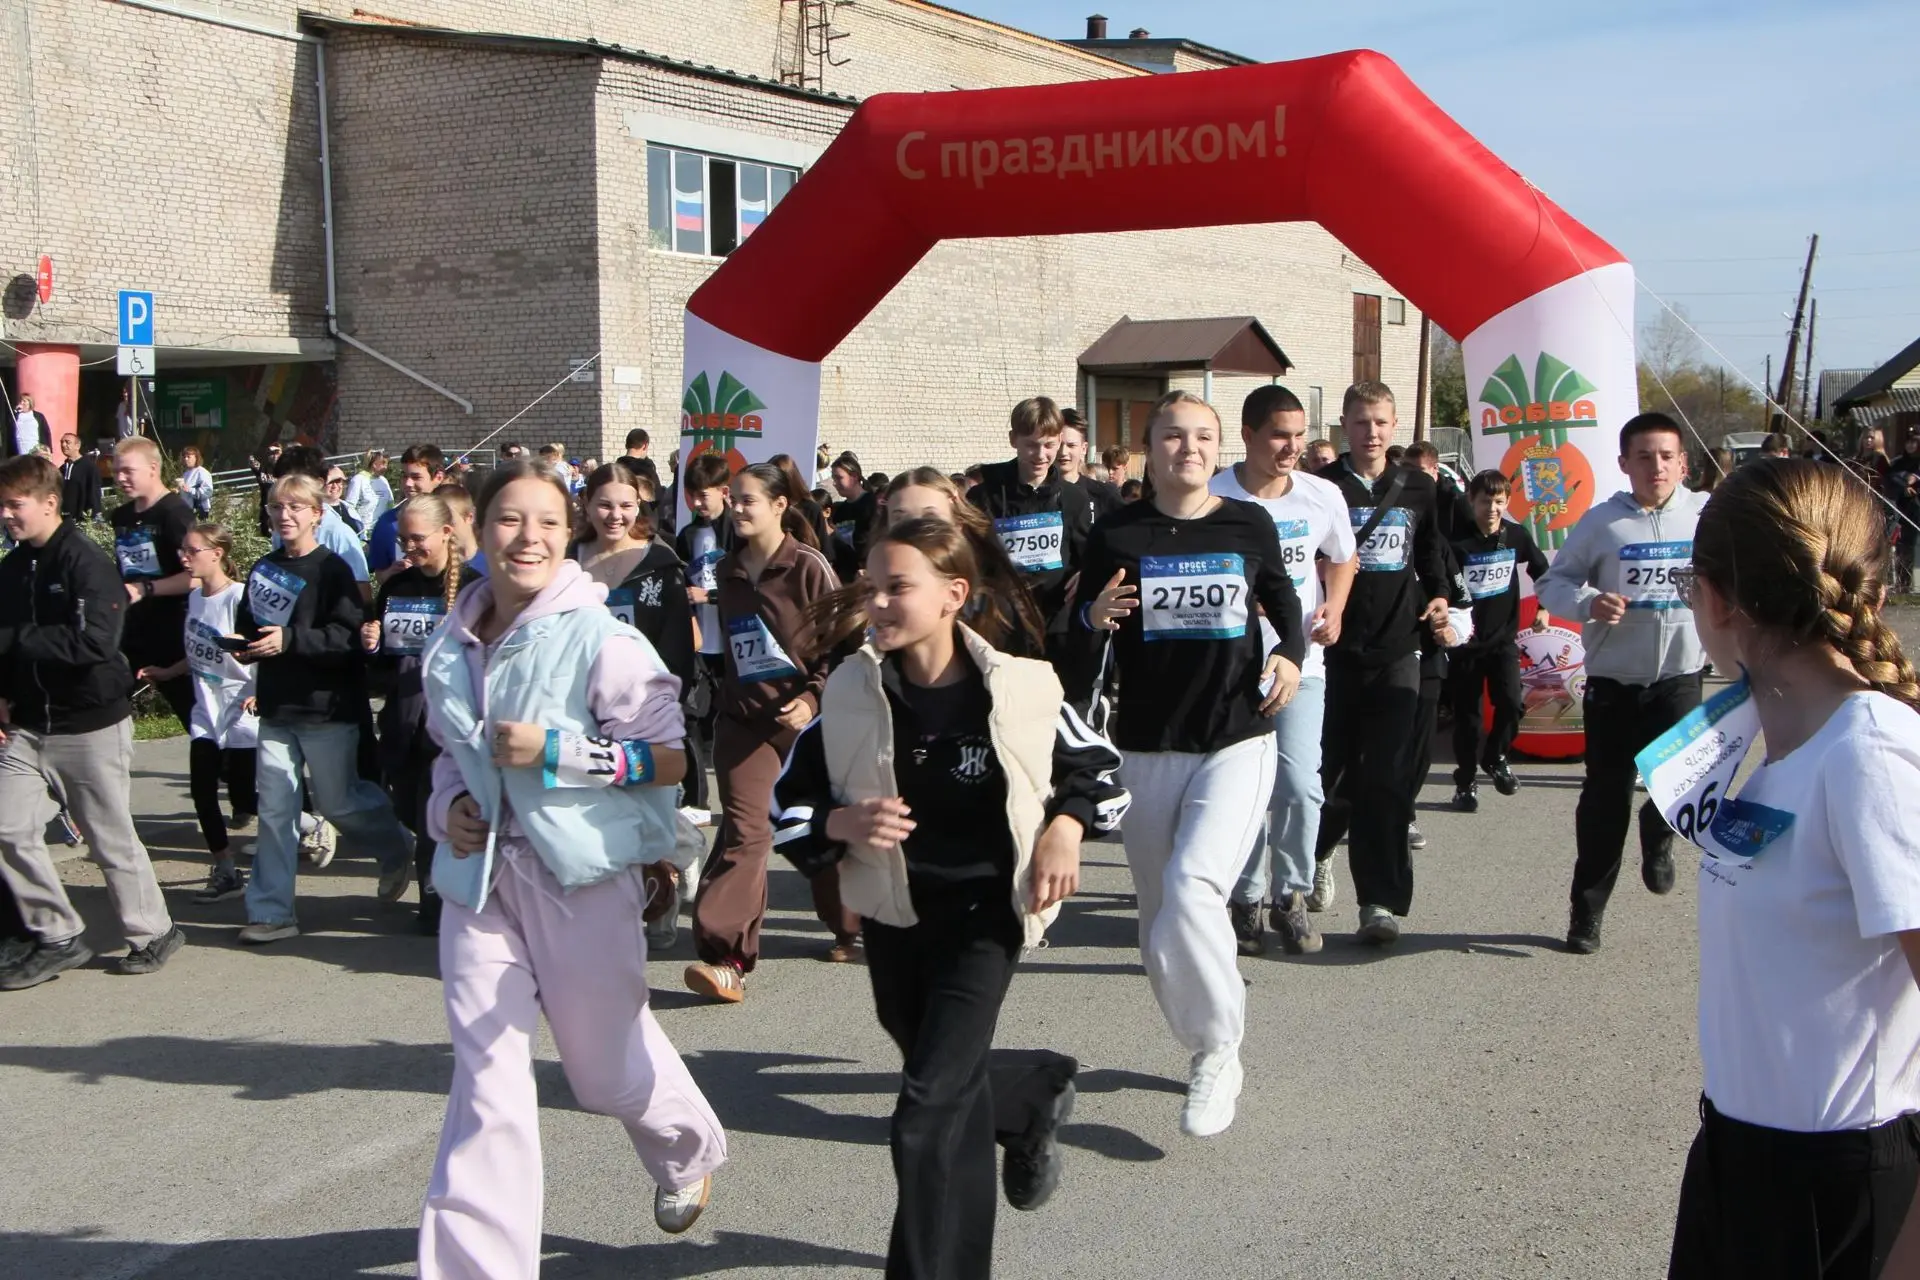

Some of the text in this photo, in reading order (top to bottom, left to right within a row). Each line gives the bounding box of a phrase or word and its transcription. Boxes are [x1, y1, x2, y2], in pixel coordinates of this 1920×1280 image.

[895, 104, 1288, 189] С праздником!
[128, 296, 148, 340] P
[1481, 399, 1596, 429] ЛОБВА
[1530, 503, 1569, 515] 1905
[1004, 533, 1059, 554] 27508
[1365, 533, 1400, 550] 570
[1282, 545, 1305, 565] 85
[1468, 566, 1511, 583] 27503
[1152, 584, 1240, 610] 27507
[187, 638, 223, 664] 7685
